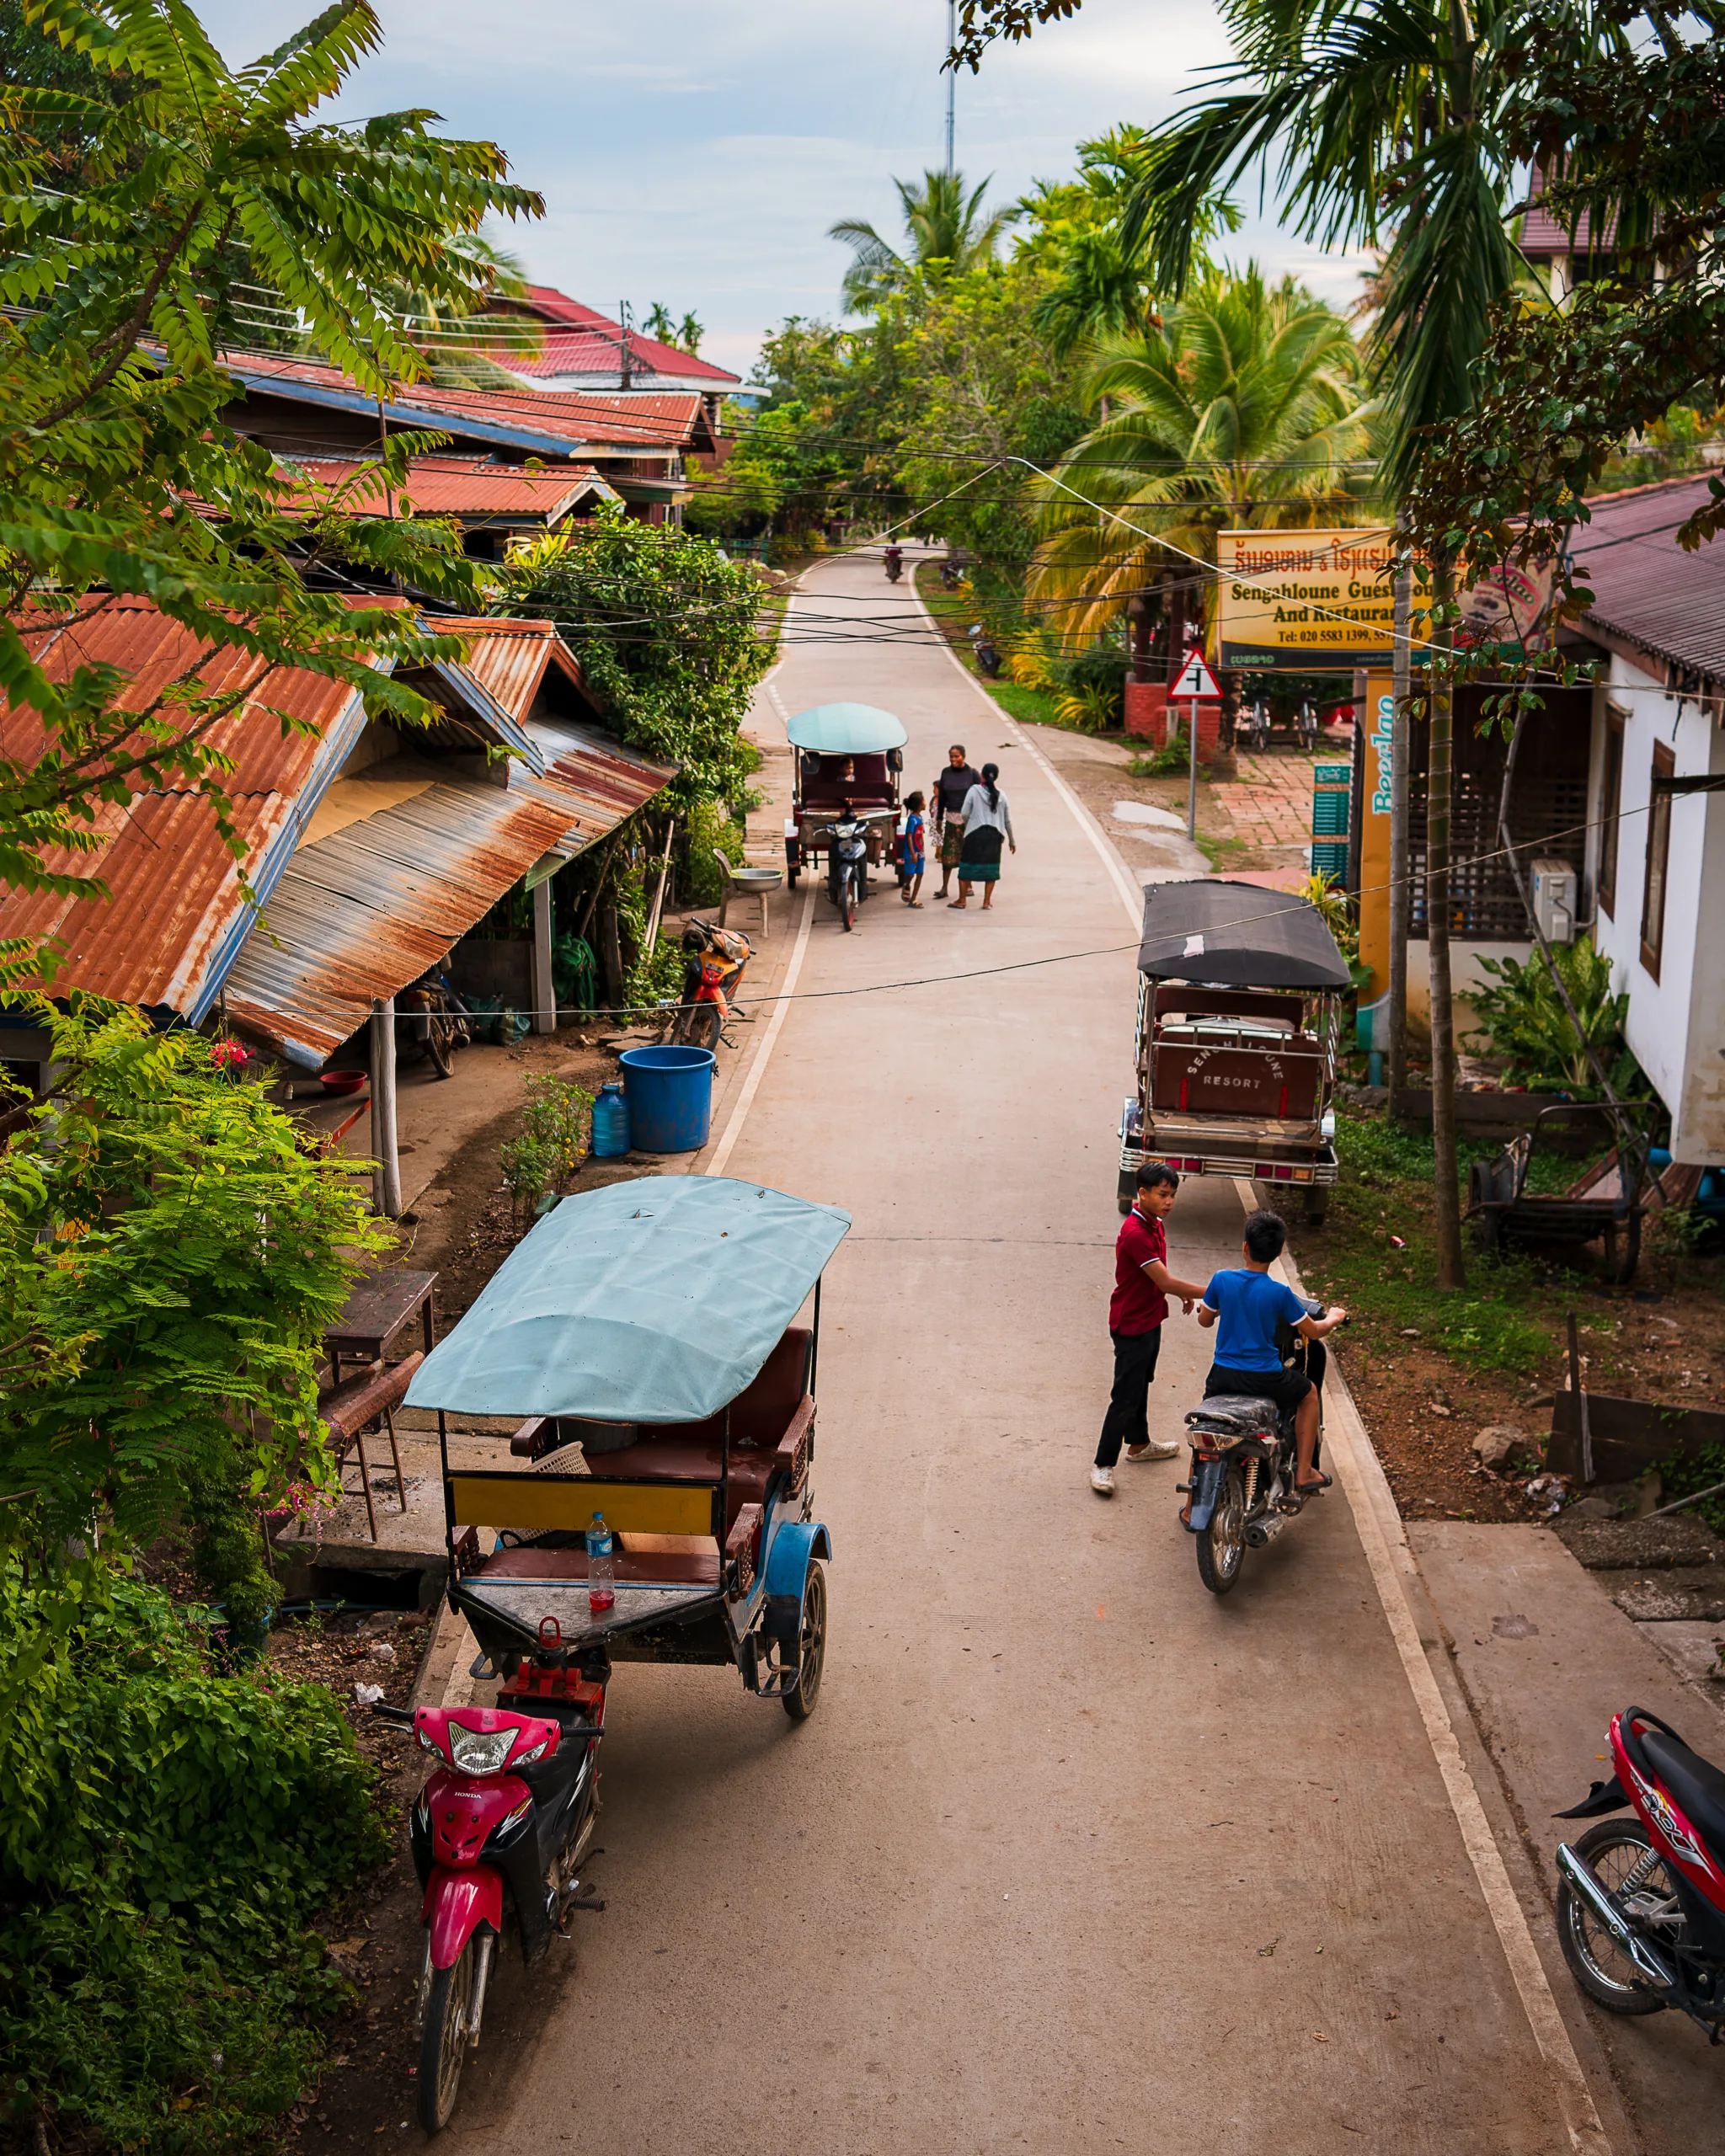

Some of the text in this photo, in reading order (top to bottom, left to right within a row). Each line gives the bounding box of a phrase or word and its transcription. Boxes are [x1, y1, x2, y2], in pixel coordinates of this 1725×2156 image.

[1231, 583, 1341, 604] Sengahloune
[1273, 606, 1309, 622] And
[1279, 631, 1298, 643] Tel:
[1300, 631, 1317, 642] 020
[1320, 630, 1343, 642] 5583
[1347, 629, 1372, 643] 1399,
[1203, 1075, 1262, 1089] RESORT
[454, 1791, 483, 1800] HONDA
